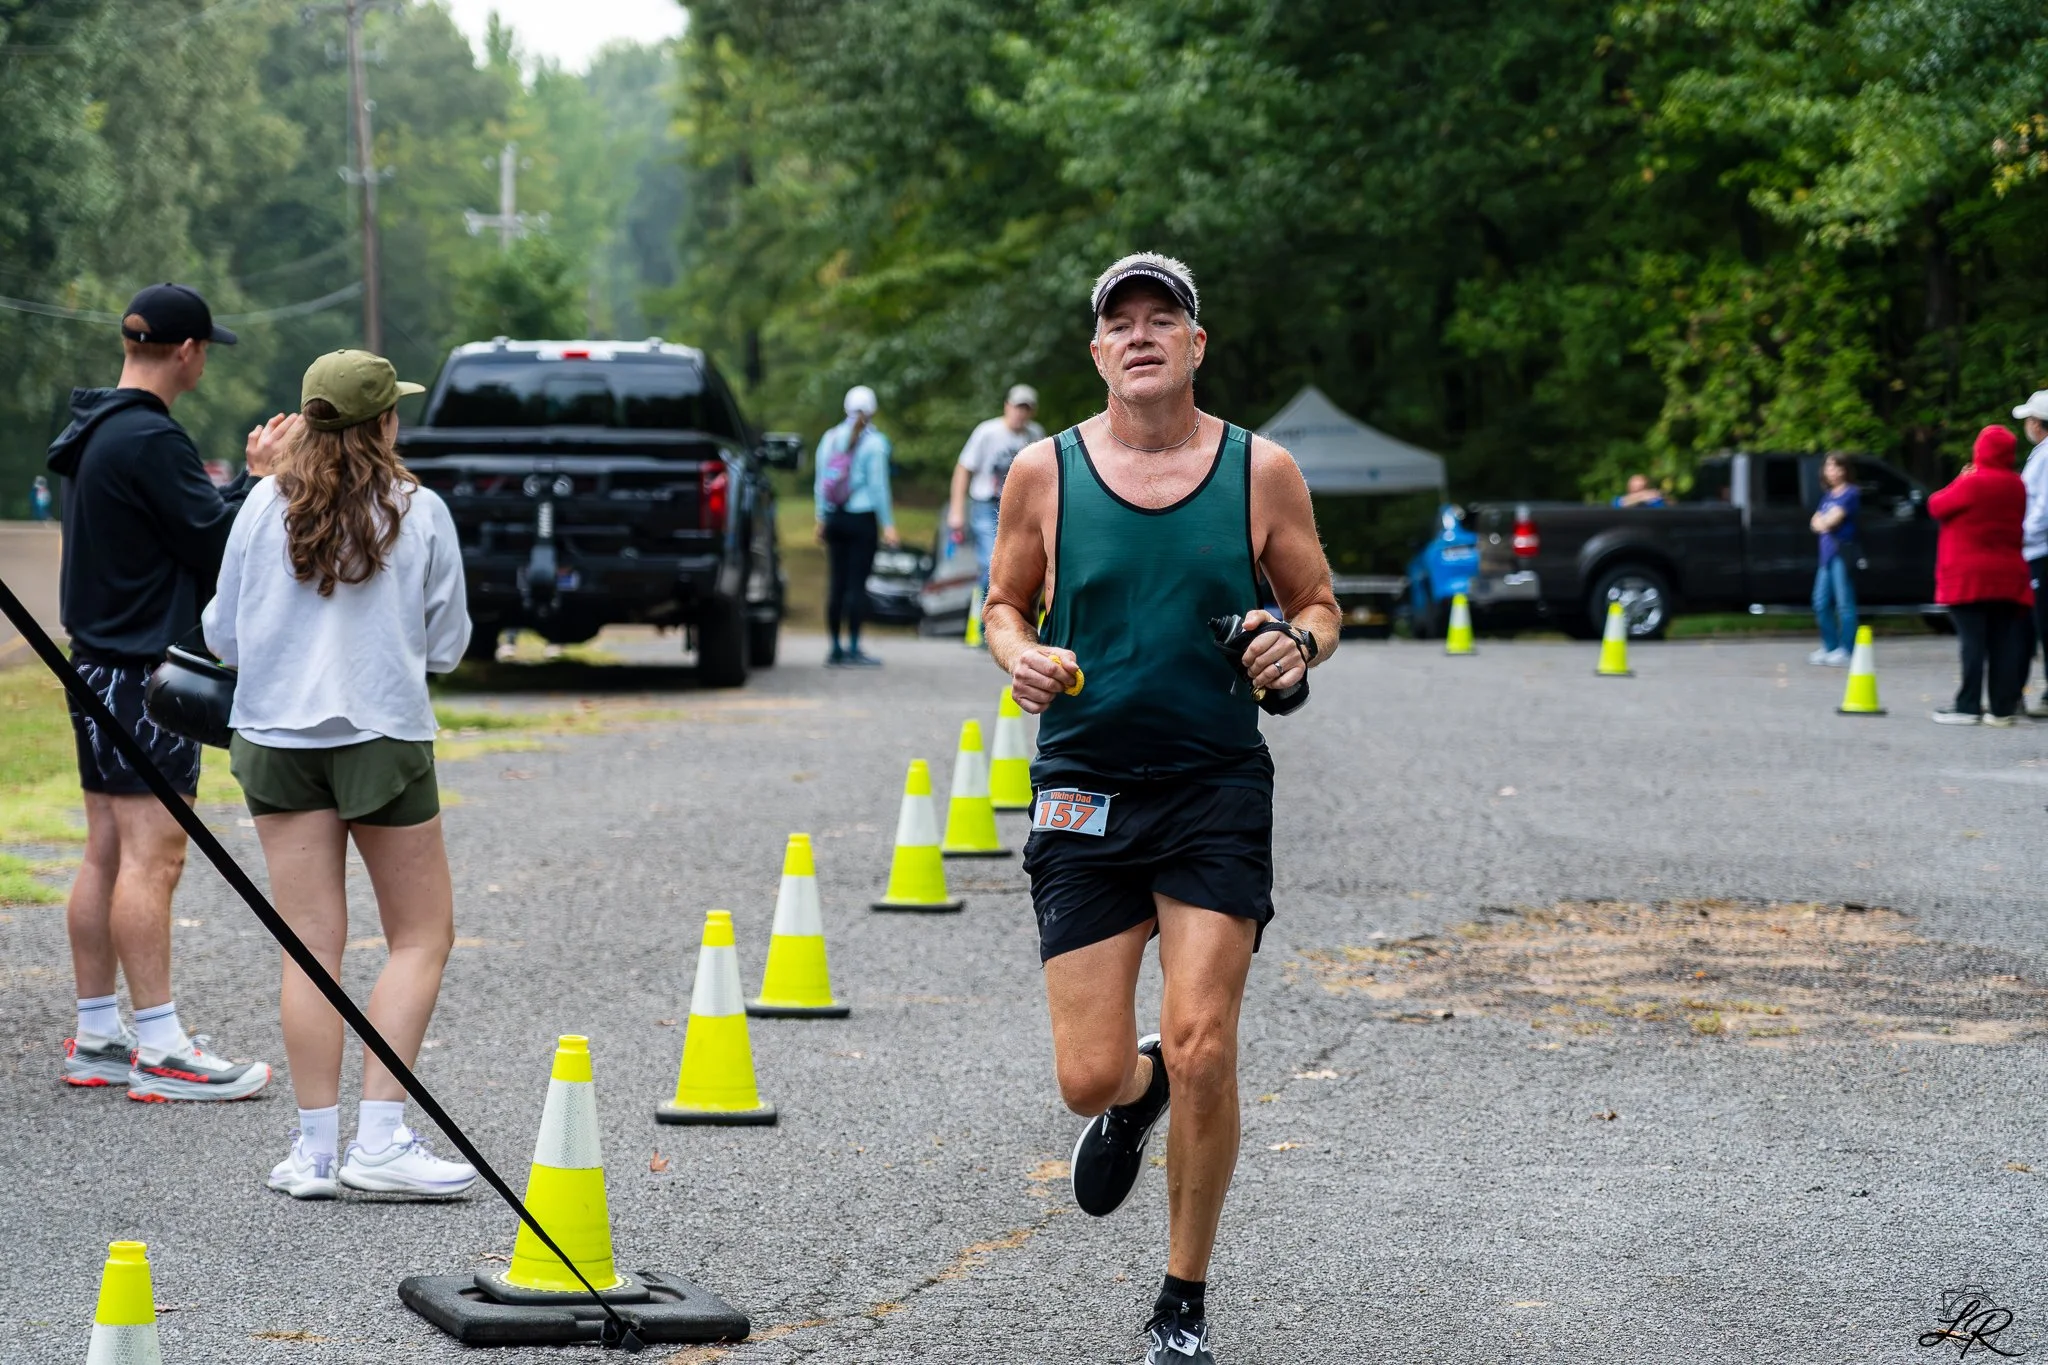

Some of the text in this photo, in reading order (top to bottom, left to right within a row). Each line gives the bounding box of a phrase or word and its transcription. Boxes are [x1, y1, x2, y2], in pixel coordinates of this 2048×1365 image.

[1117, 269, 1176, 287] RAGNAR TRAIL
[1050, 791, 1092, 803] Viking Dad
[1039, 802, 1097, 830] 157
